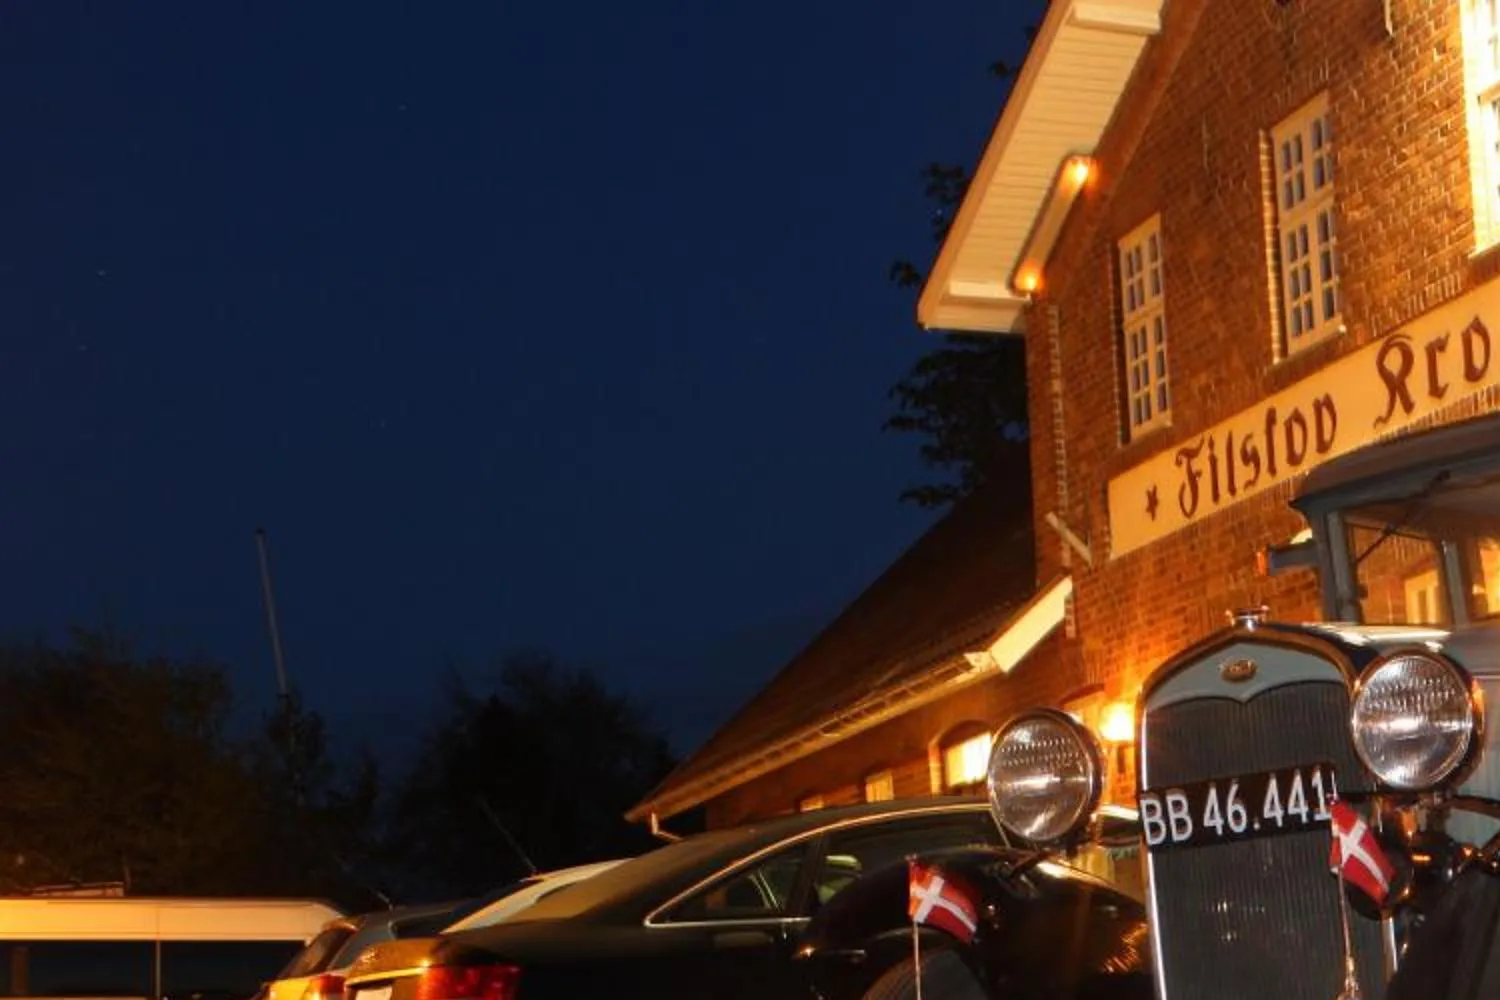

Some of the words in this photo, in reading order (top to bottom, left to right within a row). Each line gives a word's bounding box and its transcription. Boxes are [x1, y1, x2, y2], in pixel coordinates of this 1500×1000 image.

[1373, 314, 1491, 429] Kro
[1140, 790, 1193, 845] BB
[1203, 766, 1332, 836] 46.441
